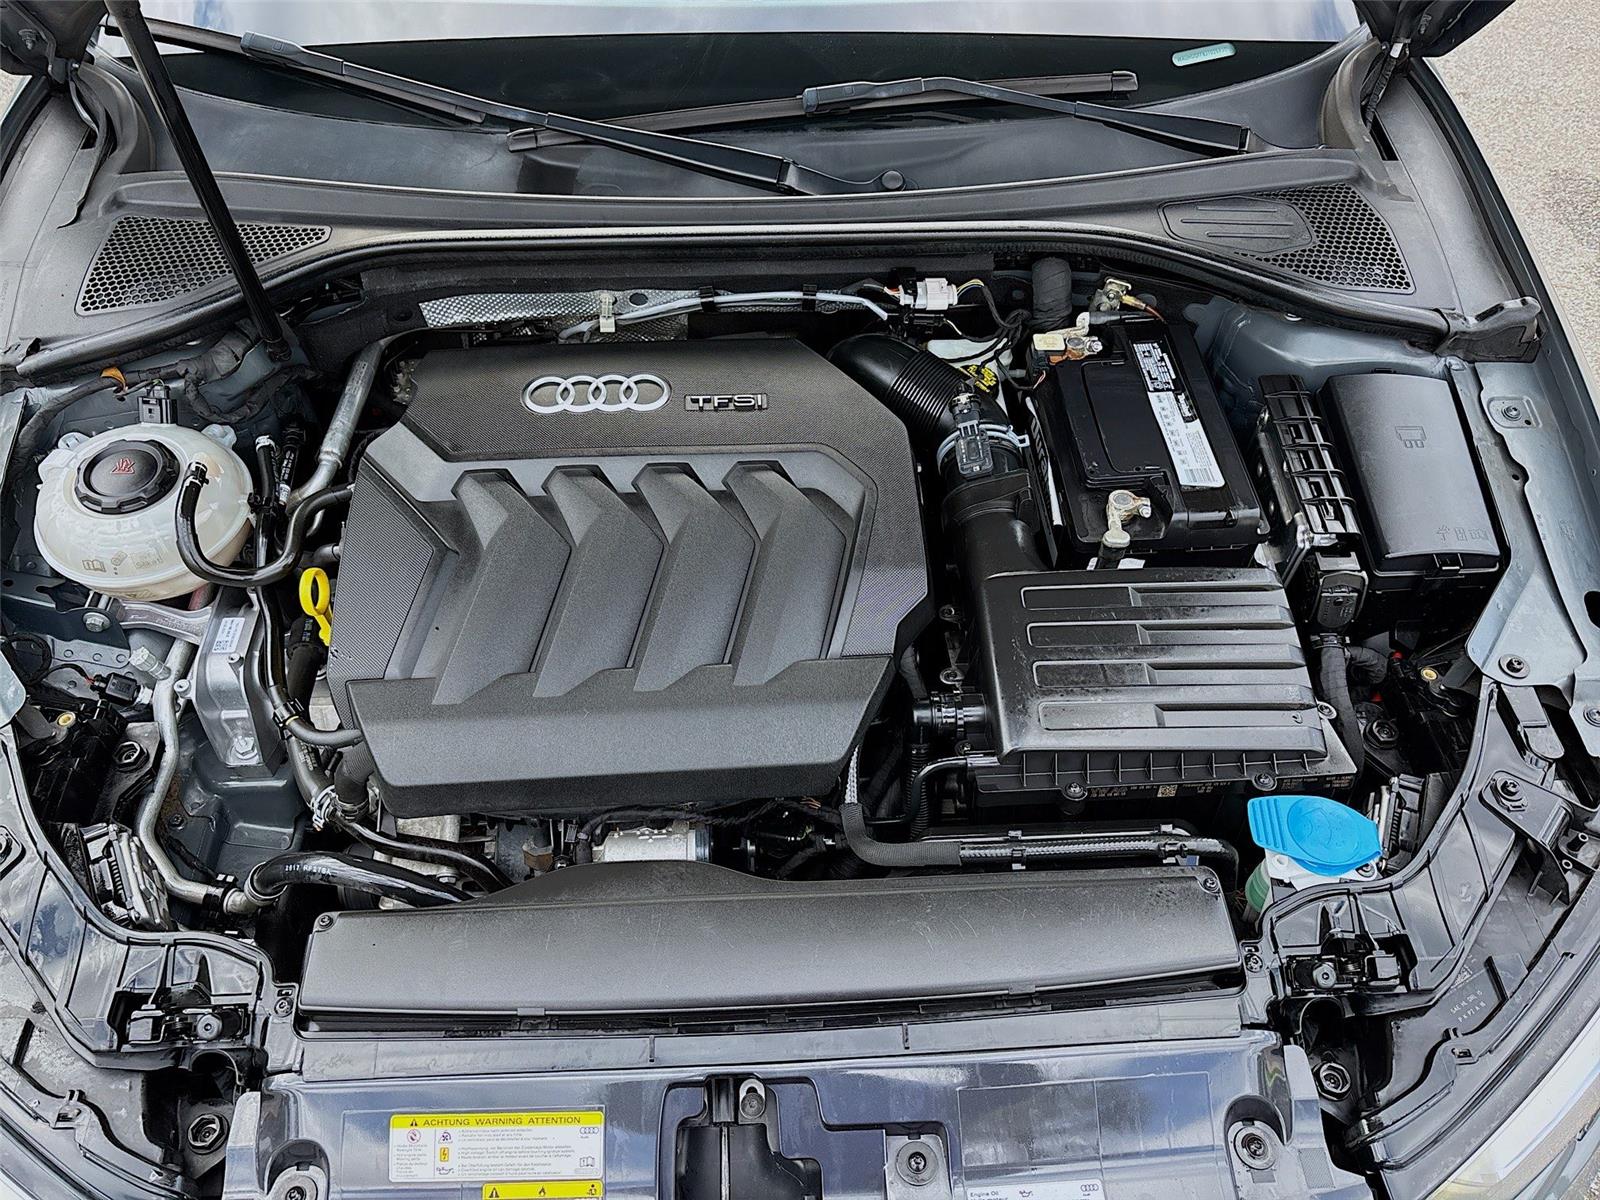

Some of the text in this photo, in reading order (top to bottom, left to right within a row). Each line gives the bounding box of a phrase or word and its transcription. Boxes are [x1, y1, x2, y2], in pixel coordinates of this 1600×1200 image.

[690, 394, 762, 411] TFSI
[423, 1116, 581, 1127] ACHTUNG WARNING ATTENTION
